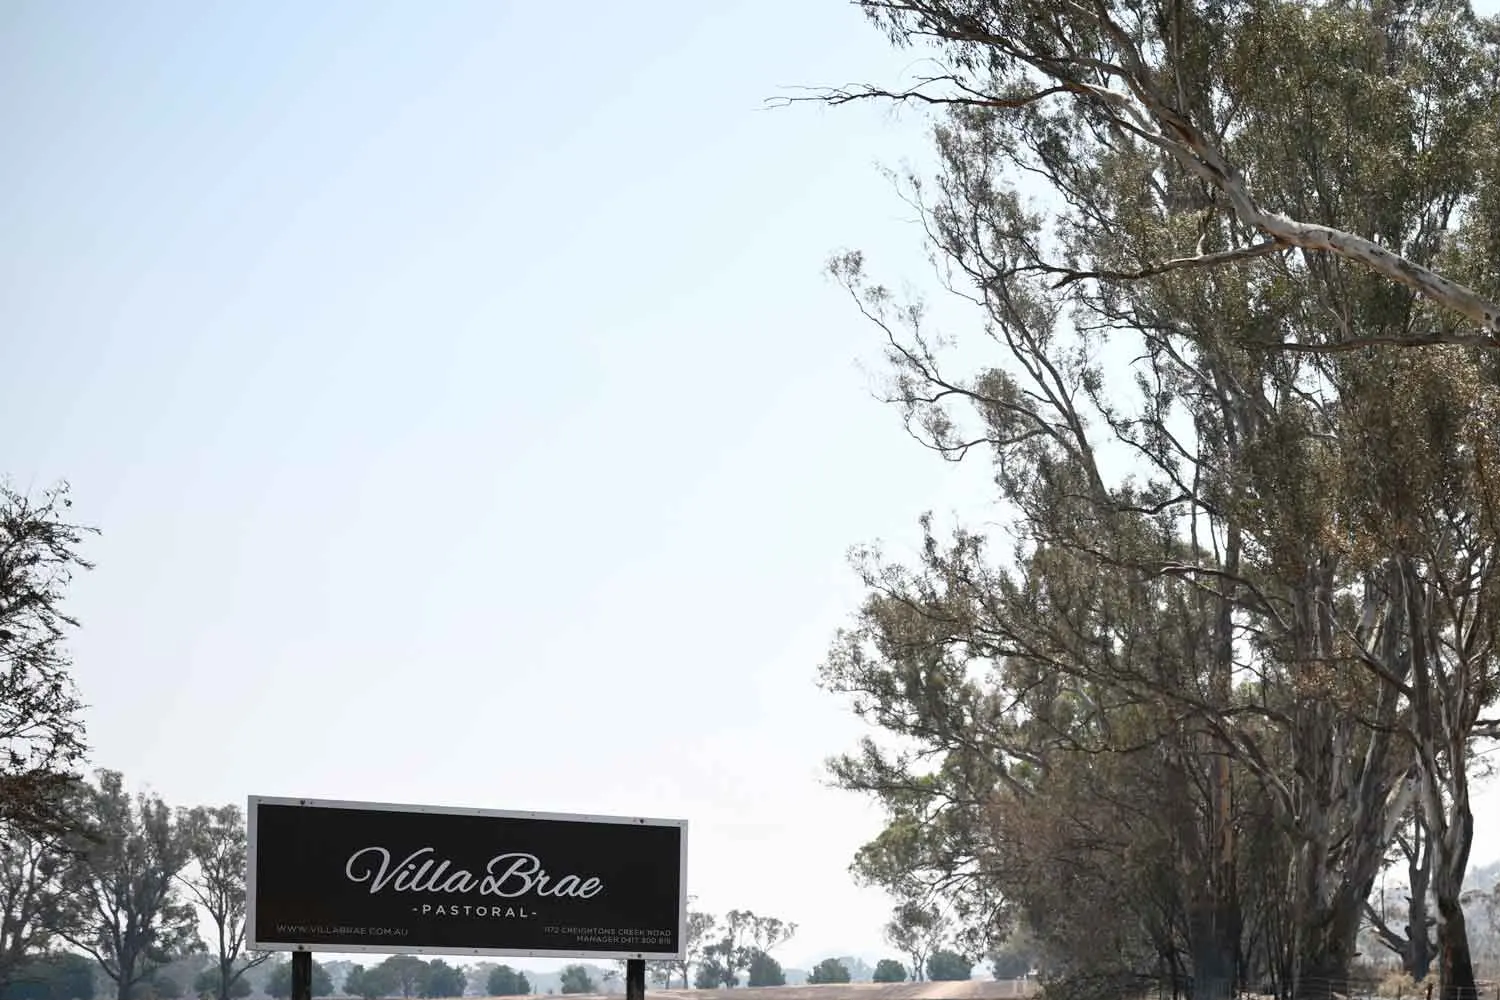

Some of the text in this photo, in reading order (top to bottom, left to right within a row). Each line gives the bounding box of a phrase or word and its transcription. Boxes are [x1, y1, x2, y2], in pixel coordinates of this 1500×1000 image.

[346, 846, 604, 899] Villa Brae
[647, 929, 672, 937] ROAD
[576, 935, 620, 943] MANAGER
